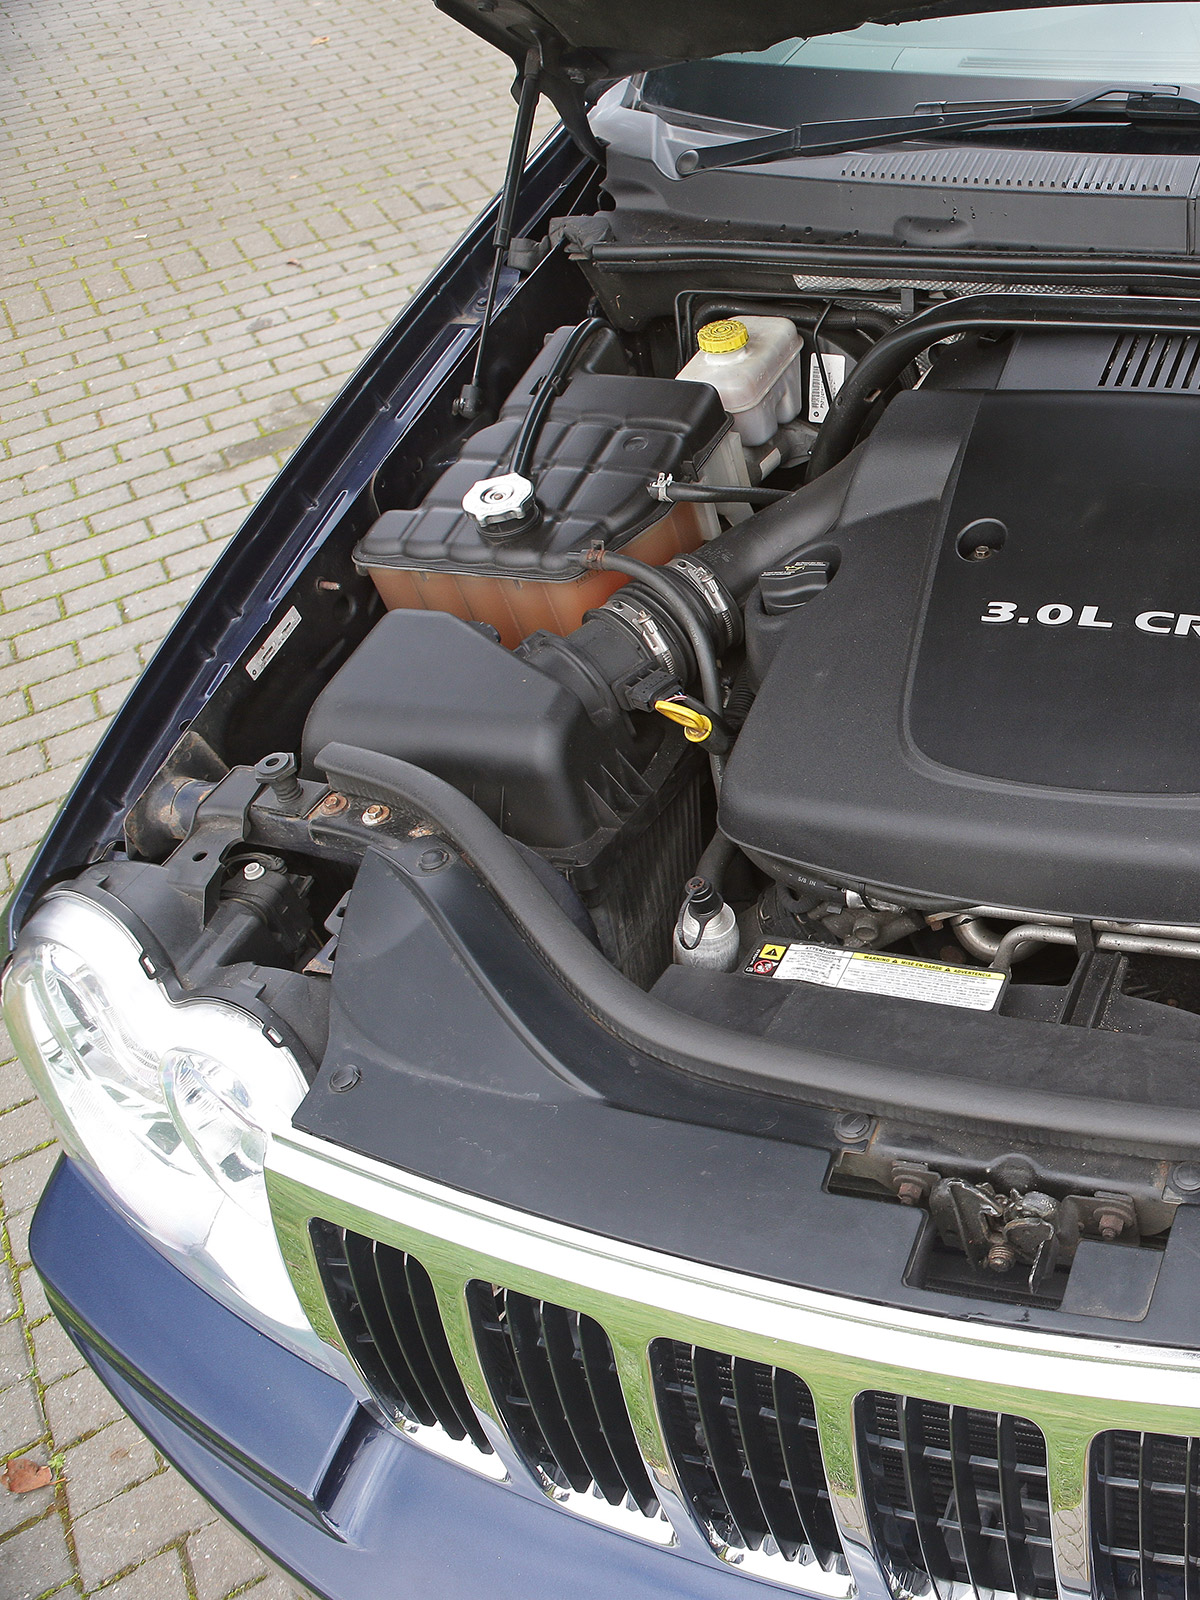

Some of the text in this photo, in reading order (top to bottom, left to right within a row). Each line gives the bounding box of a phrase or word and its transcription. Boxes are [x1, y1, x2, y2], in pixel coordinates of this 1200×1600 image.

[980, 601, 1113, 628] 3.0L
[805, 946, 837, 955] ATTENTION
[863, 954, 890, 964] WARNING
[924, 963, 943, 972] GARDE
[953, 969, 992, 978] ADVERTENCIA
